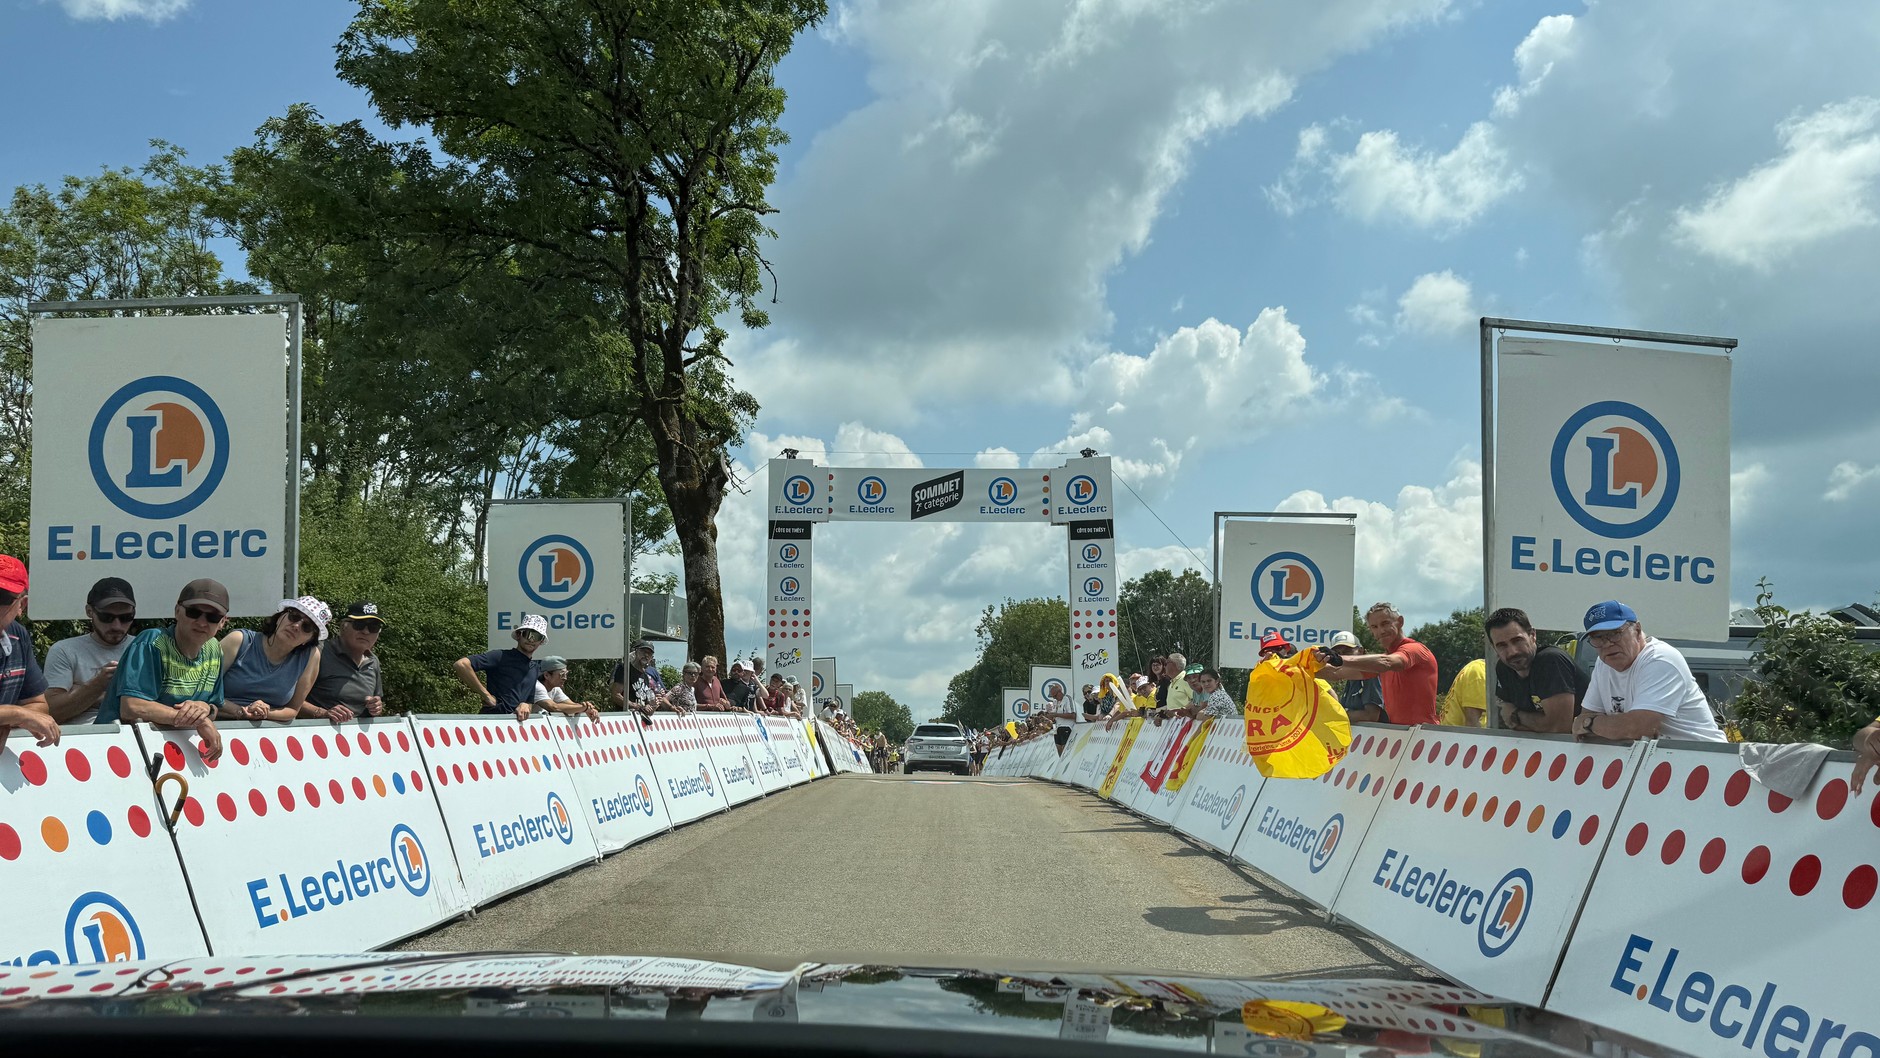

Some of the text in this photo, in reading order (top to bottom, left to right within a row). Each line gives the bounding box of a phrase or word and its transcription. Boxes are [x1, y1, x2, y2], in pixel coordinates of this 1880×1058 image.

[914, 478, 961, 503] SOMMET
[775, 505, 823, 514] E.Leclerc
[849, 505, 895, 514] E.Leclerc
[980, 506, 1026, 514] E.Leclerc
[1058, 505, 1107, 515] E.Leclerc
[47, 523, 268, 561] E.Leclerc
[1511, 535, 1715, 585] E.Leclerc
[497, 611, 615, 630] E.clerc
[668, 775, 705, 799] E.Leclerc
[1191, 785, 1228, 818] E.Leclerc
[592, 792, 641, 825] E.Leclerc
[472, 814, 554, 858] E.Leclerc
[1257, 805, 1317, 854] E.Leclerc
[246, 857, 396, 929] E.Leclerc
[1372, 848, 1484, 925] E.Leclerc
